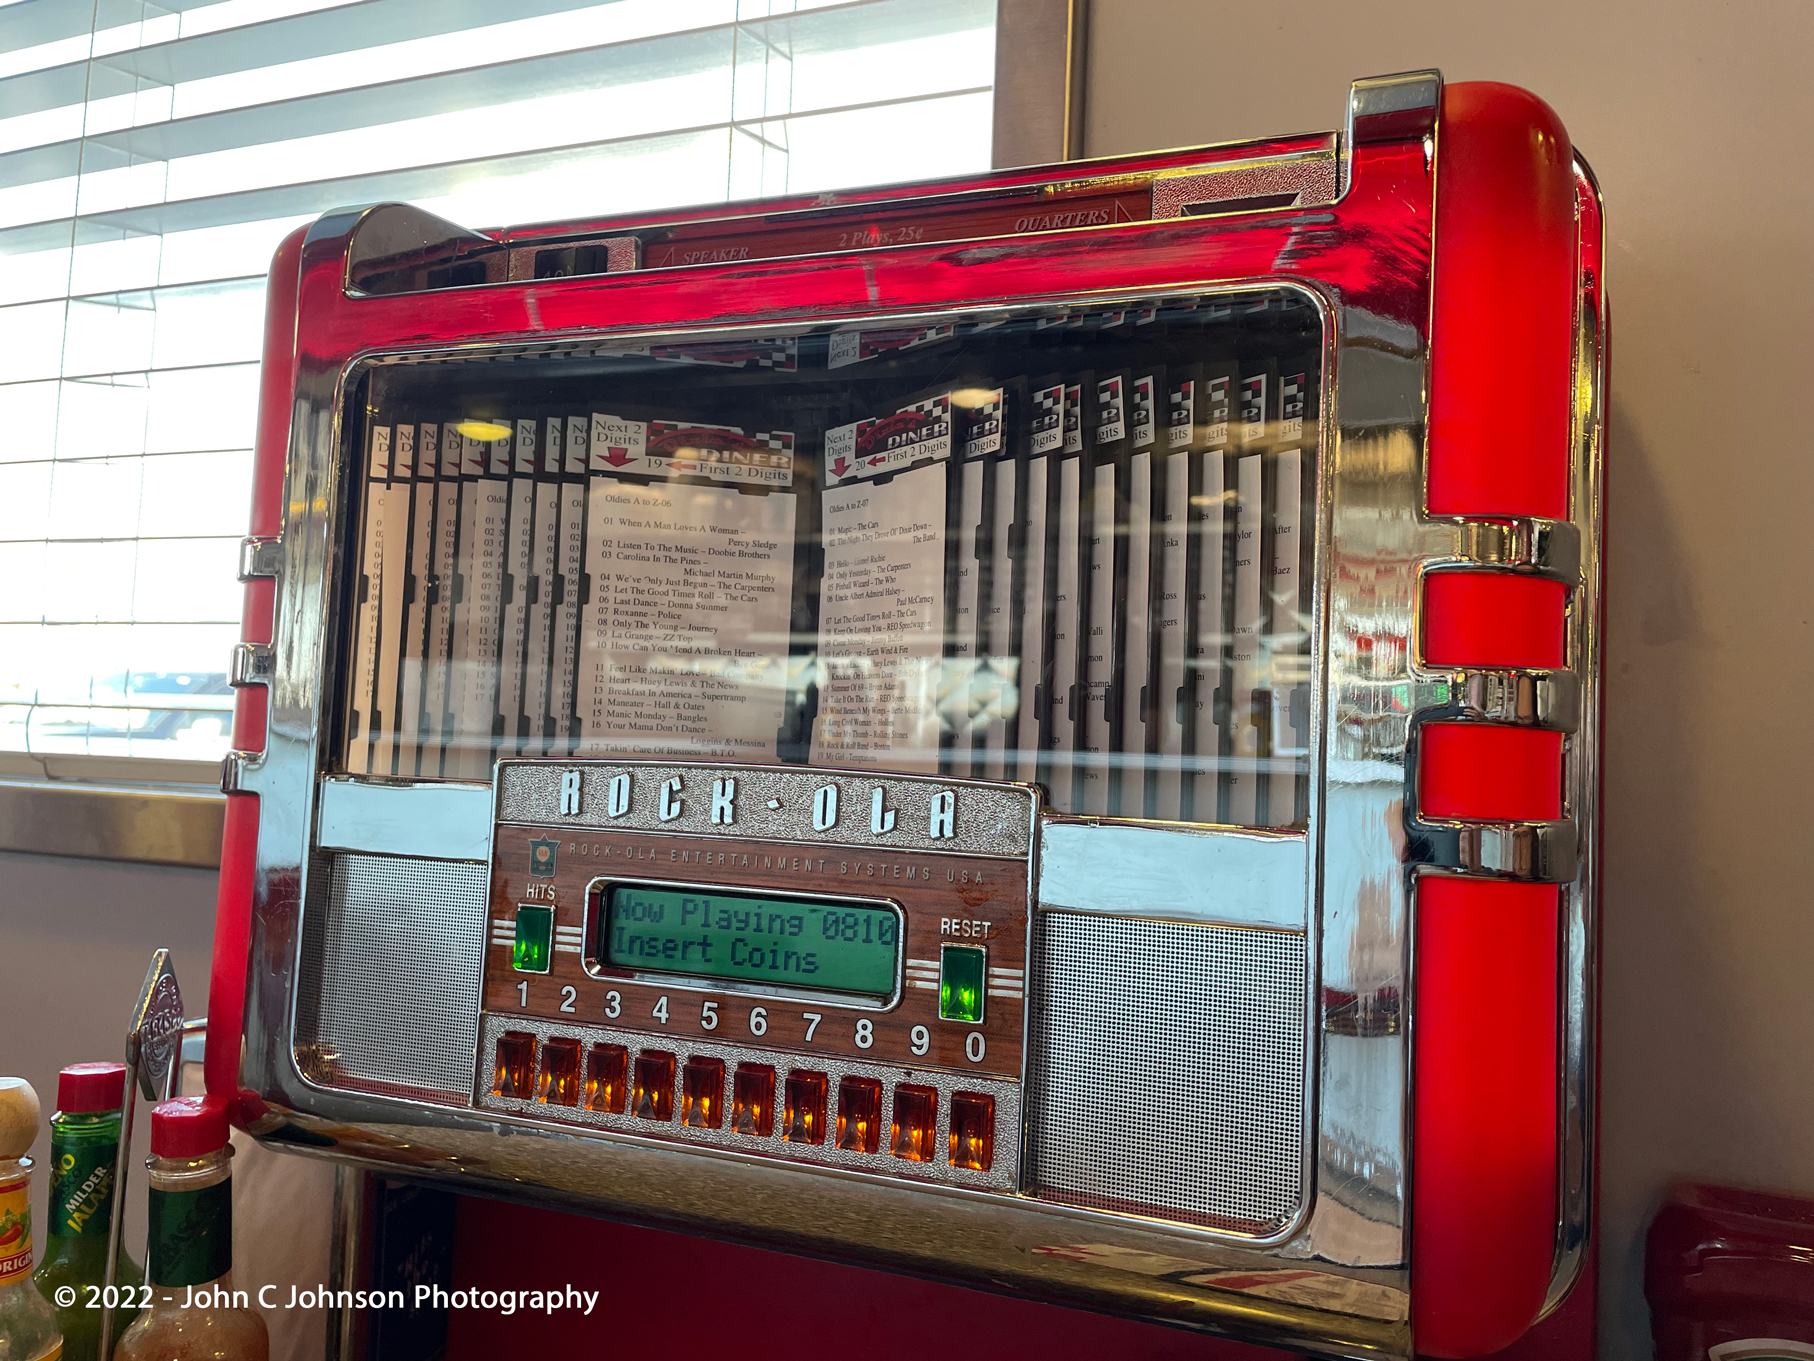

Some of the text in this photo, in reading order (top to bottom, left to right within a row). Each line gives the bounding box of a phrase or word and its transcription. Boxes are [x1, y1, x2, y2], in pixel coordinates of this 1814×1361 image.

[1015, 207, 1110, 234] QUARTERS
[839, 233, 849, 248] 2
[898, 226, 924, 243] 25¢
[683, 246, 749, 266] SPEAKER
[595, 420, 642, 435] Next 2
[887, 421, 949, 449] DINER
[596, 432, 640, 446] Digits
[827, 429, 854, 446] Next 2
[828, 443, 852, 458] Digits
[887, 440, 948, 463] First 2 Digits
[969, 439, 997, 455] Digits
[647, 457, 663, 469] 19
[700, 448, 792, 468] DINER
[856, 459, 866, 471] 20
[699, 463, 789, 481] First 2 Digits
[605, 495, 672, 508] Oldies A to Z-06
[603, 517, 739, 535] 01 When A Man Loves A Woman
[602, 539, 771, 560] 02 Listen To The Music Doobie Brothers
[728, 538, 778, 551] Percy Sledge
[601, 551, 701, 566] 03 Carolina In The Pines
[600, 573, 611, 582] 04
[616, 574, 642, 584] We've
[665, 577, 681, 586] Just
[683, 578, 708, 590] Begun
[717, 580, 732, 590] The
[734, 581, 775, 595] Carpenters
[683, 567, 775, 585] Michael Martin Murphy
[599, 584, 758, 602] 05 Let The Good Times Roll The Cars
[598, 596, 609, 605] 06
[613, 596, 631, 606] Last
[633, 598, 658, 608] Dance
[667, 600, 694, 610] Donna
[598, 607, 682, 619] 07 Roxanne Police
[597, 618, 719, 635] 08 Only The Young Journey
[607, 698, 705, 711] Maneater Hall Oates
[608, 687, 747, 704] Breakfast America Supertramp
[606, 709, 708, 724] Manic Monday Bangles
[606, 721, 706, 733] Your Mama Dance
[560, 770, 736, 825] ROCK
[570, 842, 656, 860] ROCK-OLA
[670, 849, 825, 871] ENTERTAINMENT
[841, 861, 930, 880] SYSTEMS
[947, 869, 983, 884] USA
[526, 883, 556, 900] HITS
[614, 891, 896, 946] Now Playing 0810
[941, 918, 992, 938] RESET
[615, 926, 819, 974] Insert Coins
[516, 980, 985, 1063] 1 2 3 4 5 6 7 8 9 0
[65, 1166, 108, 1213] MILDER
